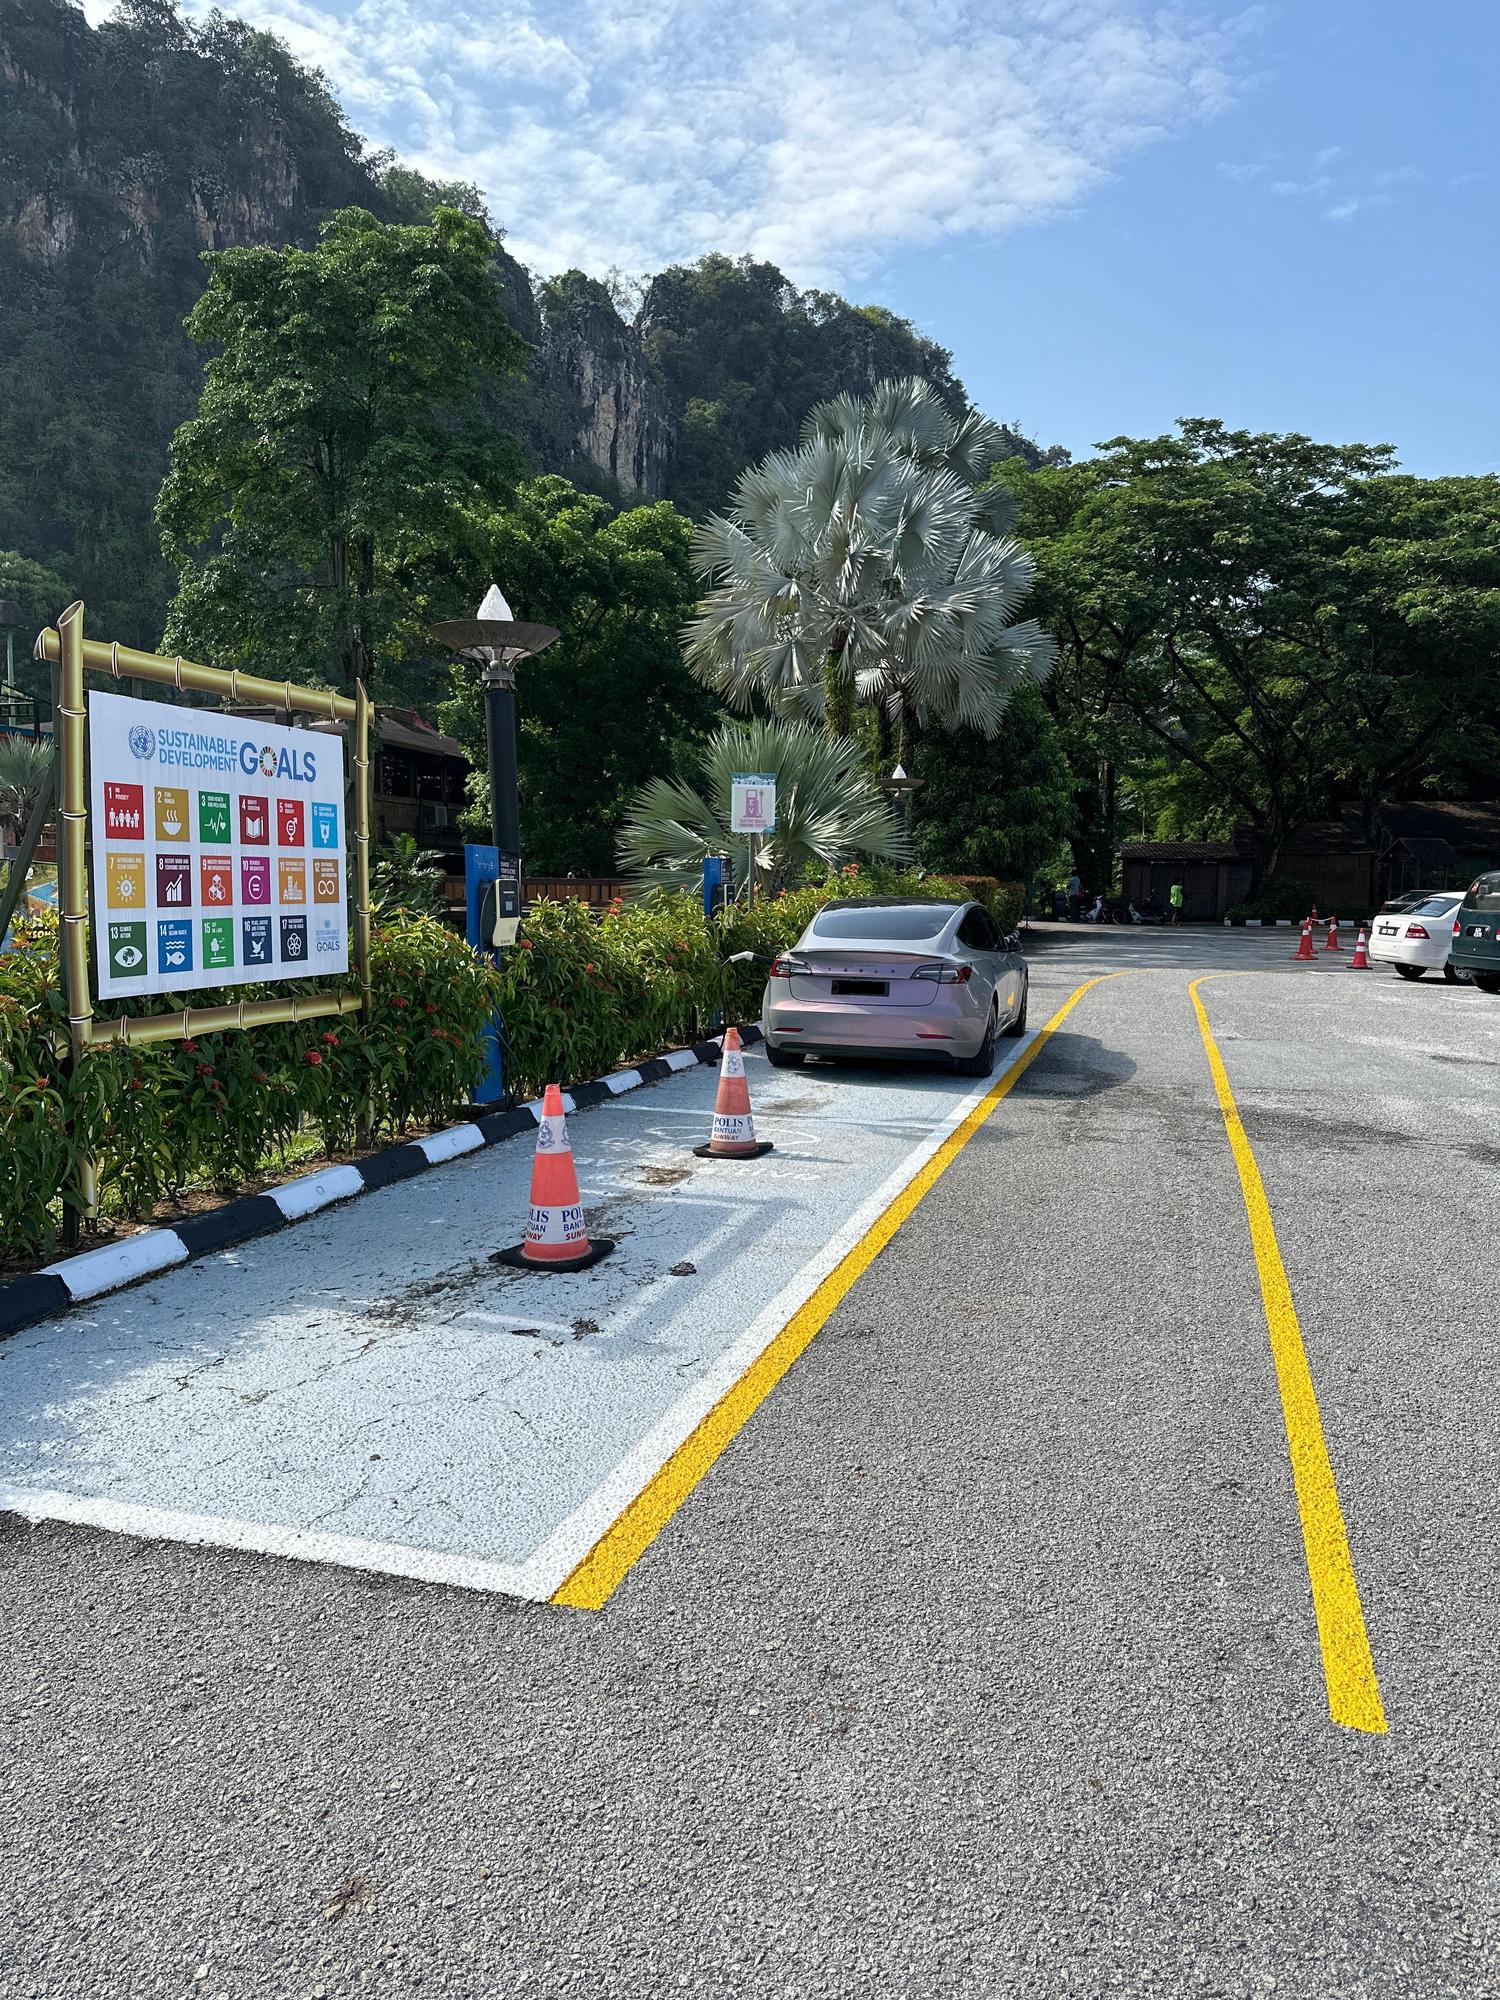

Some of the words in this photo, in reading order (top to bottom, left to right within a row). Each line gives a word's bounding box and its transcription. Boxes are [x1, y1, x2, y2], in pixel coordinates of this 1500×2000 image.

[158, 728, 238, 756] SUSTAINABLE
[159, 748, 238, 773] DEVELOPMENT
[239, 741, 317, 783] GOALS
[108, 786, 113, 800] 1
[157, 791, 162, 804] 2
[201, 795, 206, 807] 3
[242, 799, 247, 811] 4
[279, 802, 284, 813] 5
[313, 806, 318, 817] 6
[110, 857, 115, 870] 7
[159, 858, 164, 870] 8
[202, 859, 207, 871] 9
[242, 860, 249, 871] 10
[280, 861, 286, 872] 11
[159, 924, 167, 937] 14
[204, 922, 211, 934] 15
[244, 920, 251, 932] 16
[282, 919, 288, 930] 17
[110, 926, 119, 940] 13
[316, 941, 340, 952] GOALS
[714, 1116, 744, 1128] POLIS
[529, 1208, 550, 1223] LIS
